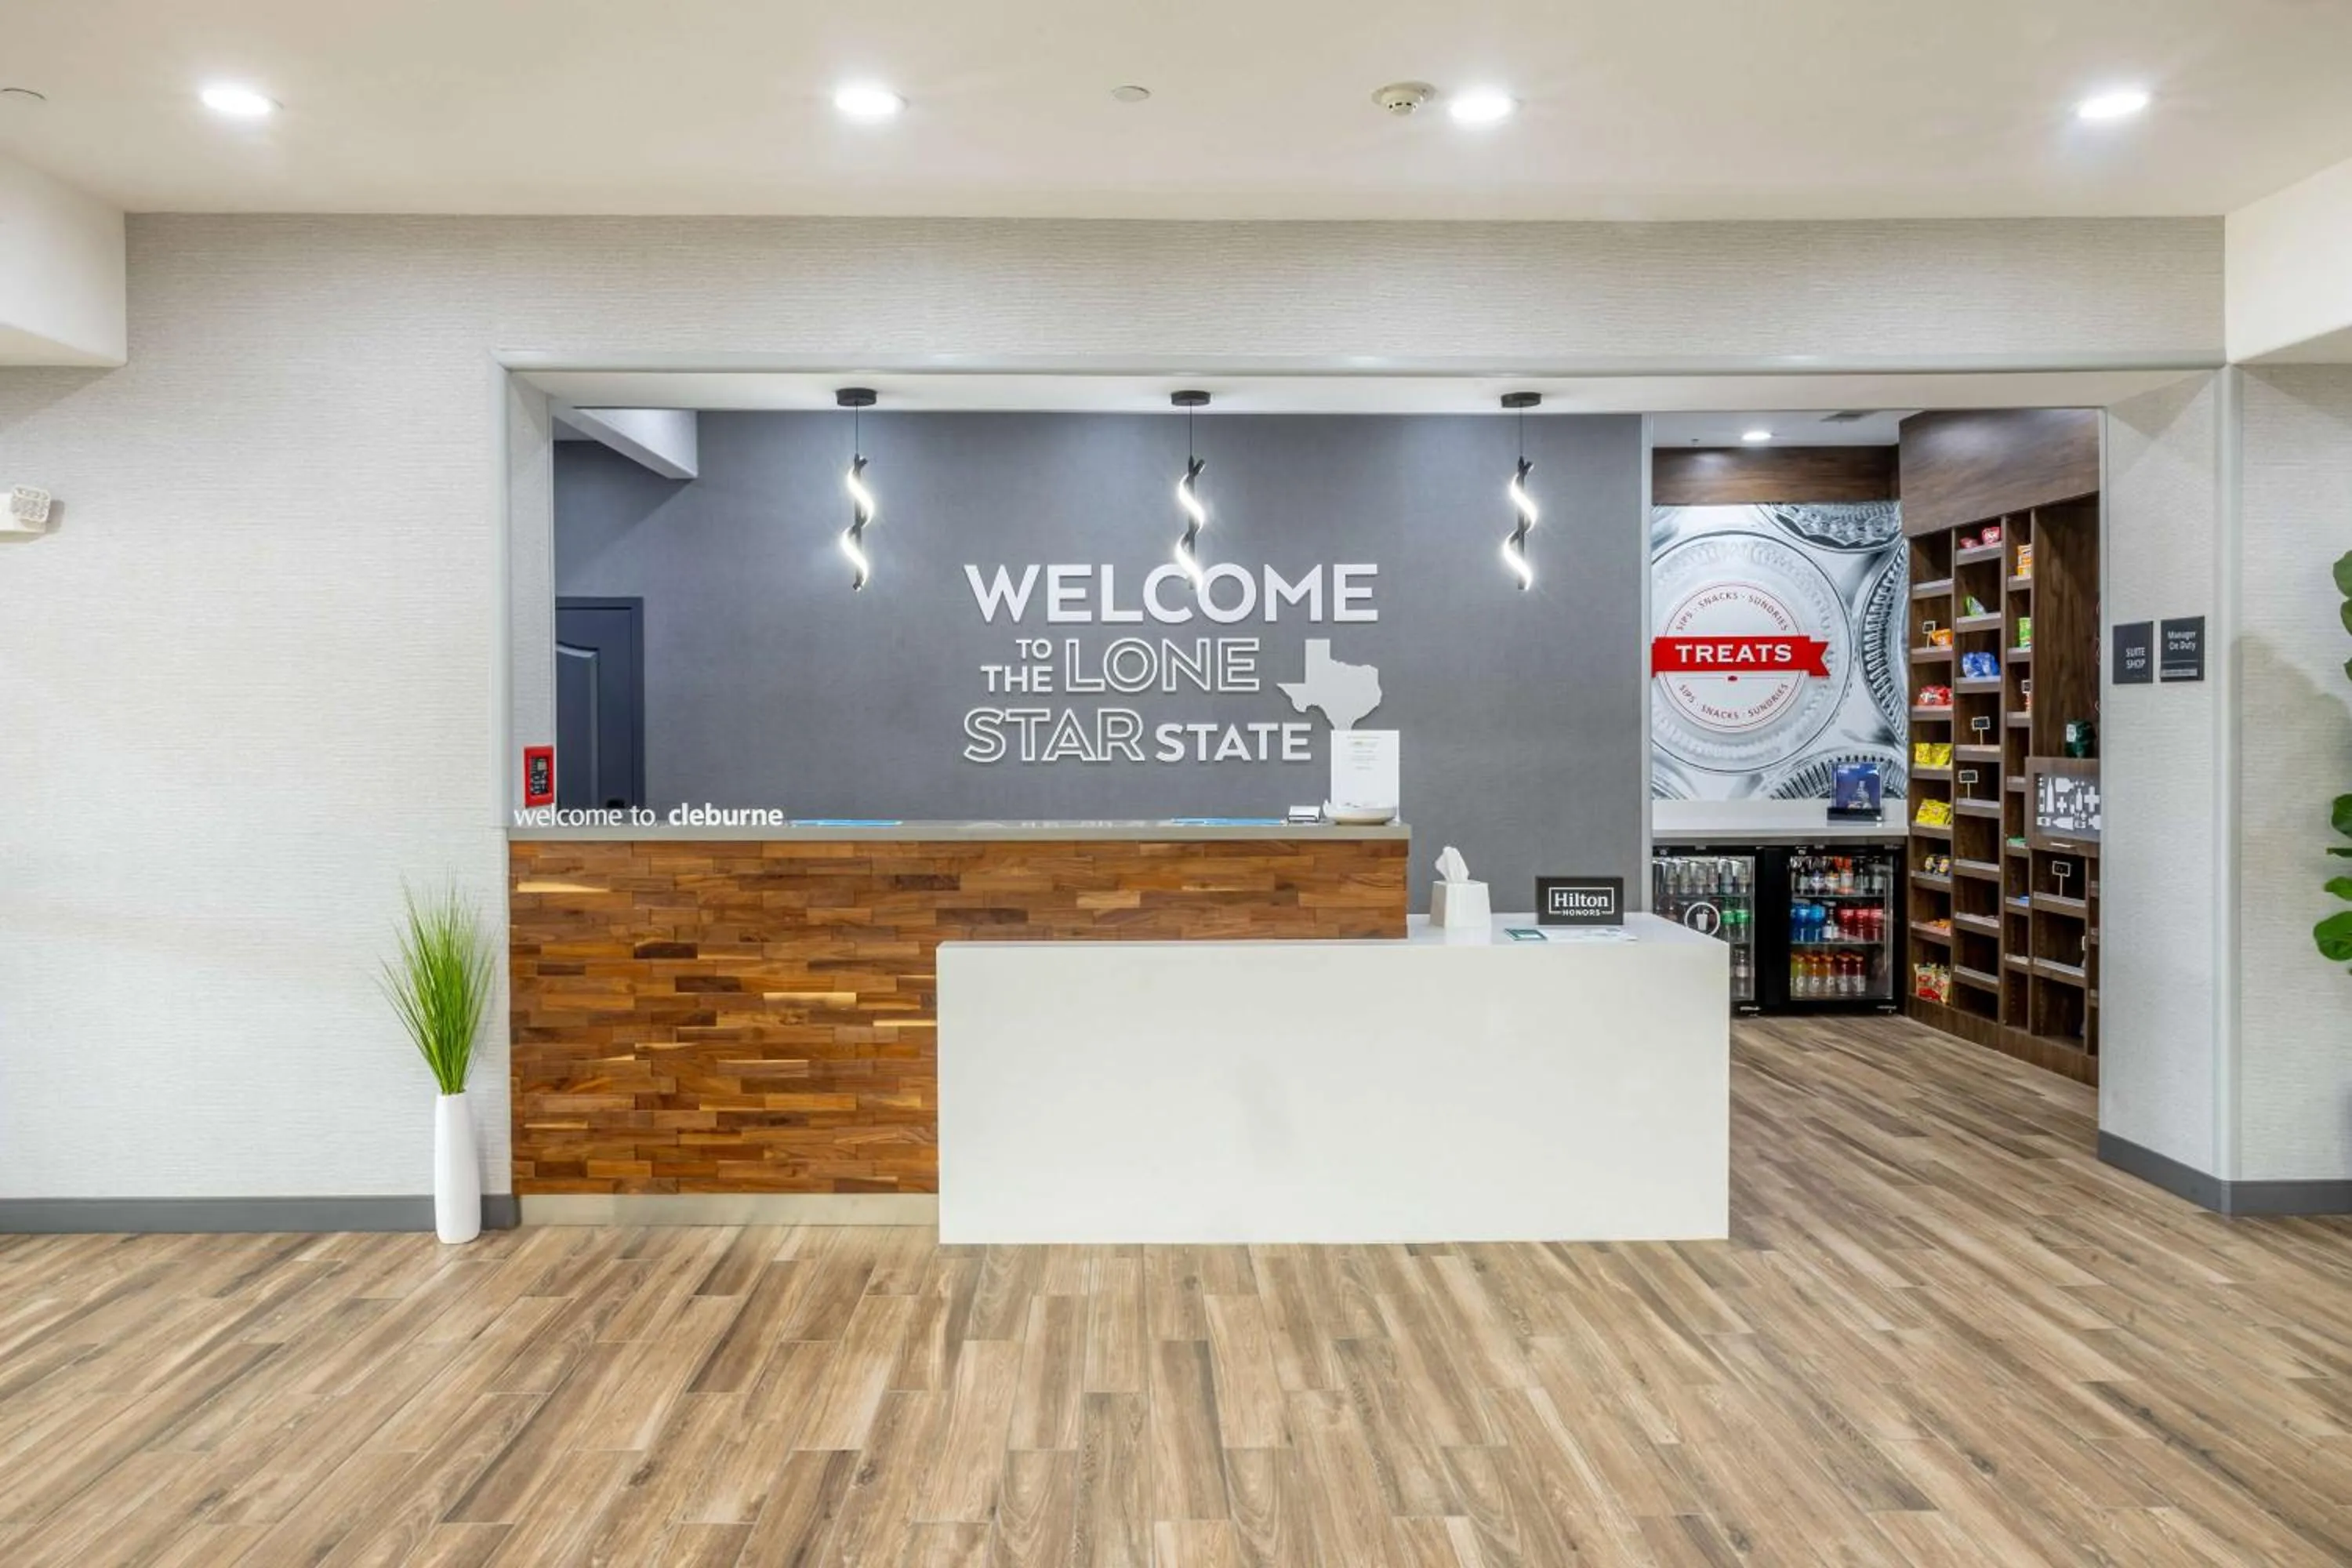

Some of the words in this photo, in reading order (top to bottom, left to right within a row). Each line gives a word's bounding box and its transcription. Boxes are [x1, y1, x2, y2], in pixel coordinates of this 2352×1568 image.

[964, 564, 1378, 623] WELCOME
[1676, 611, 1693, 630] SIPS
[1698, 592, 1738, 608] SNACKS
[1748, 595, 1788, 631] SUNDRIES
[981, 665, 1053, 692] THE
[1065, 637, 1260, 692] LONE
[1016, 639, 1052, 659] TO
[1675, 644, 1792, 662] TREATS
[1679, 684, 1695, 703] SIPS
[1701, 705, 1739, 720] SNACKS
[1748, 683, 1788, 717] SUNDRIES
[964, 708, 1145, 763] STAR
[1155, 723, 1312, 762] STATE
[514, 803, 622, 826] welcome
[630, 805, 656, 826] to
[668, 802, 784, 826] cleburne
[1555, 892, 1609, 907] Hilton
